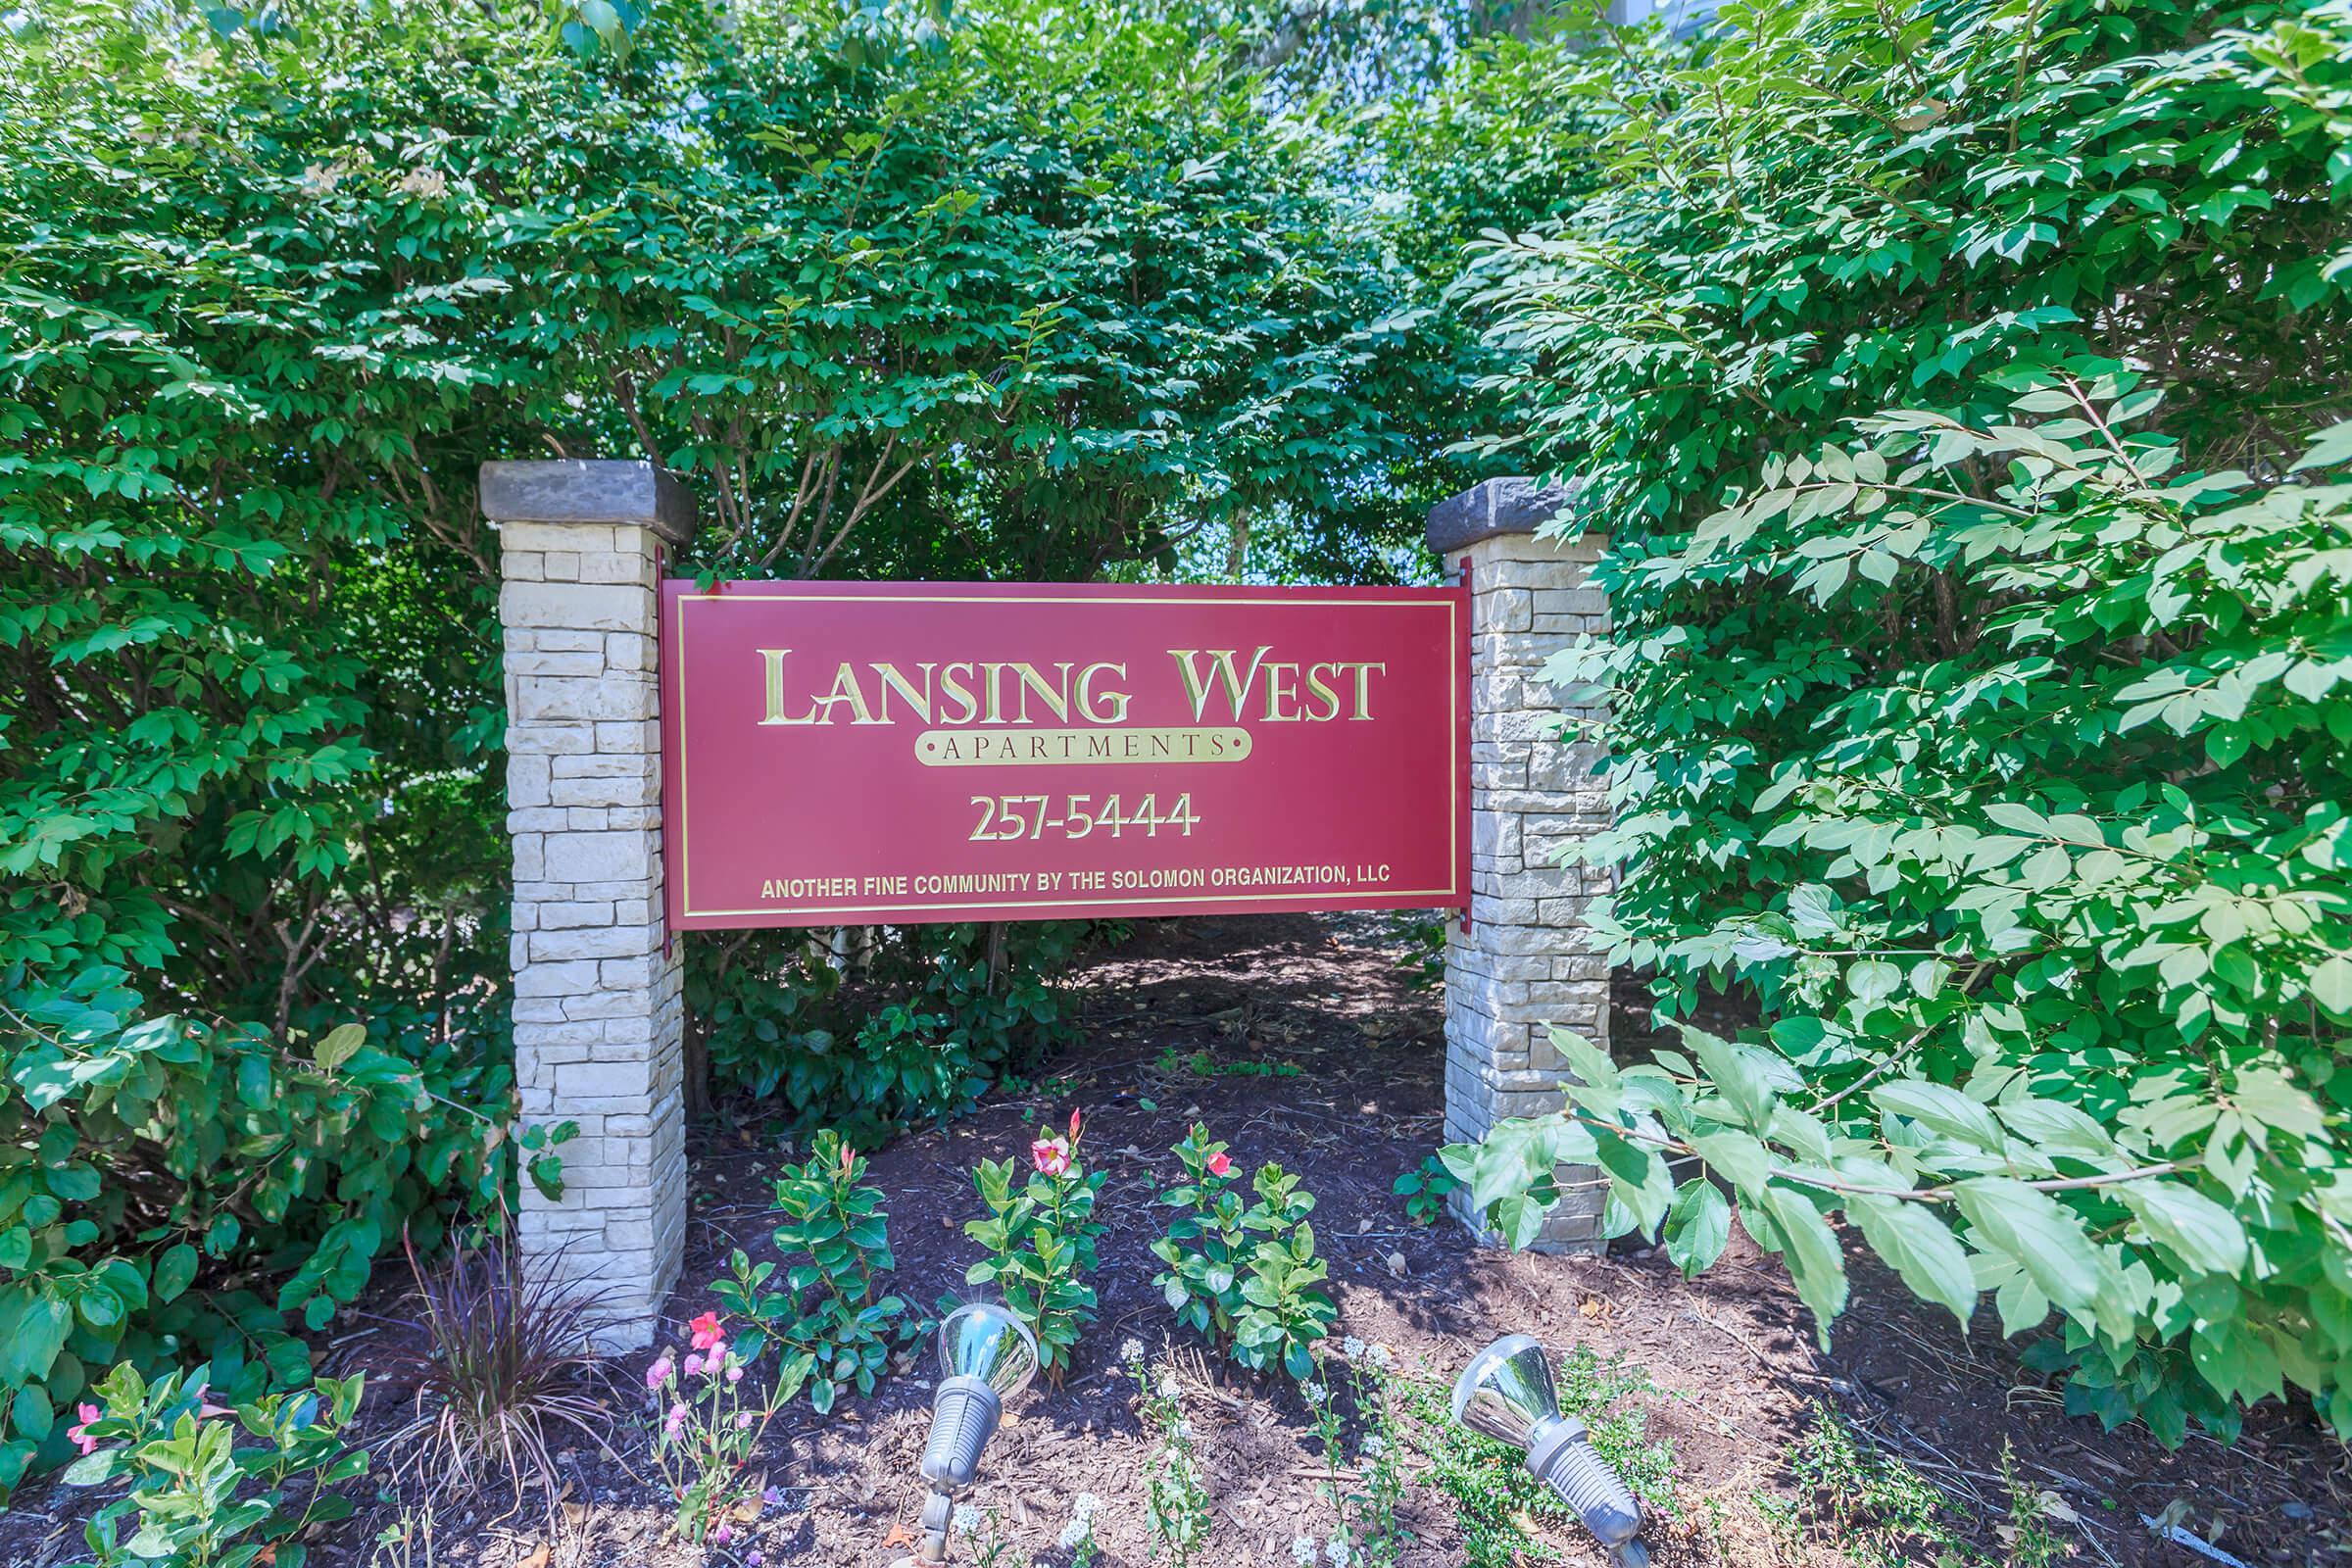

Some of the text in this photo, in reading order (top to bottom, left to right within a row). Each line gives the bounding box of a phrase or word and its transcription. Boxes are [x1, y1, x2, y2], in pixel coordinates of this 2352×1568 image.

[943, 734, 1224, 760] APARTMENTS
[967, 792, 1201, 841] 257-5444
[760, 863, 1391, 899] ANOTHER FINE COMMUNITY BY THE SOLOMON ORGANIZATION, LLC
